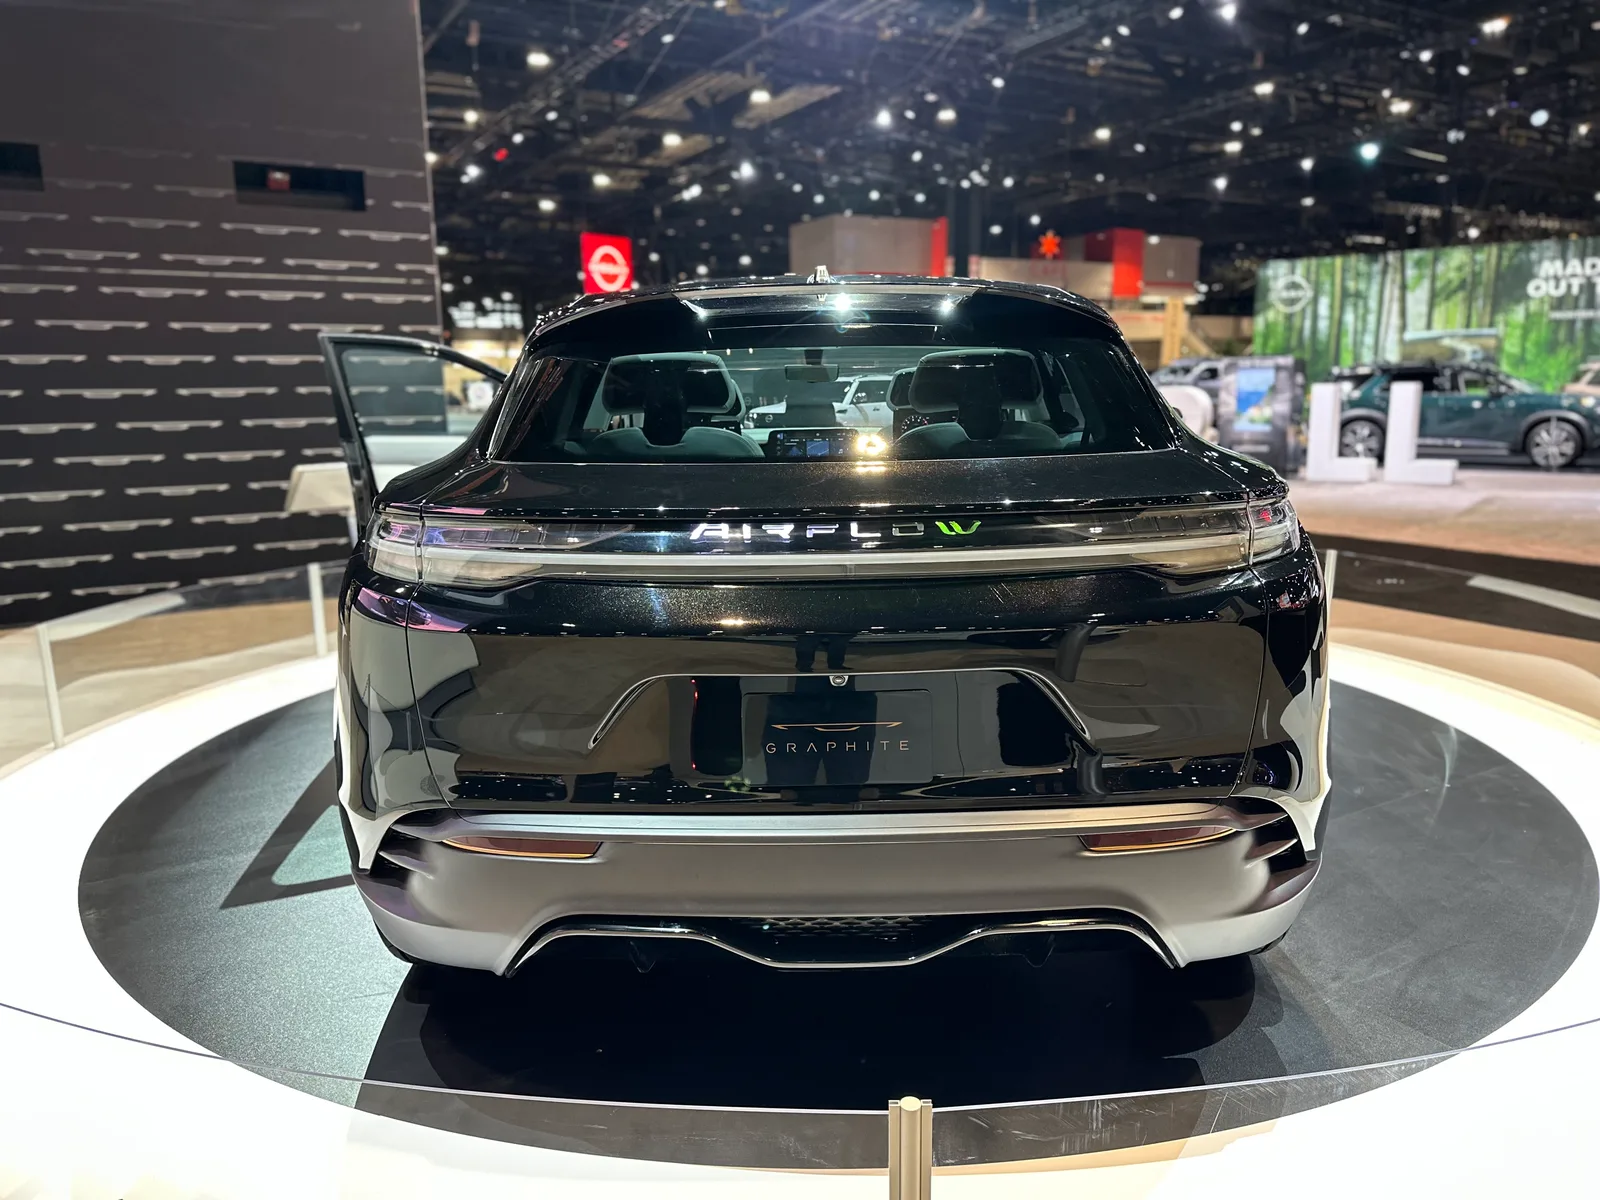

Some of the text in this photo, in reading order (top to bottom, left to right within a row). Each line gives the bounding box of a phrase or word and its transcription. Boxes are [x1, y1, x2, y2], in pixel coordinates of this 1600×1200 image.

[1539, 257, 1600, 278] MAD
[1526, 277, 1586, 298] OUT
[689, 519, 982, 540] AIRFLOW
[765, 740, 910, 754] GRAPHITE
